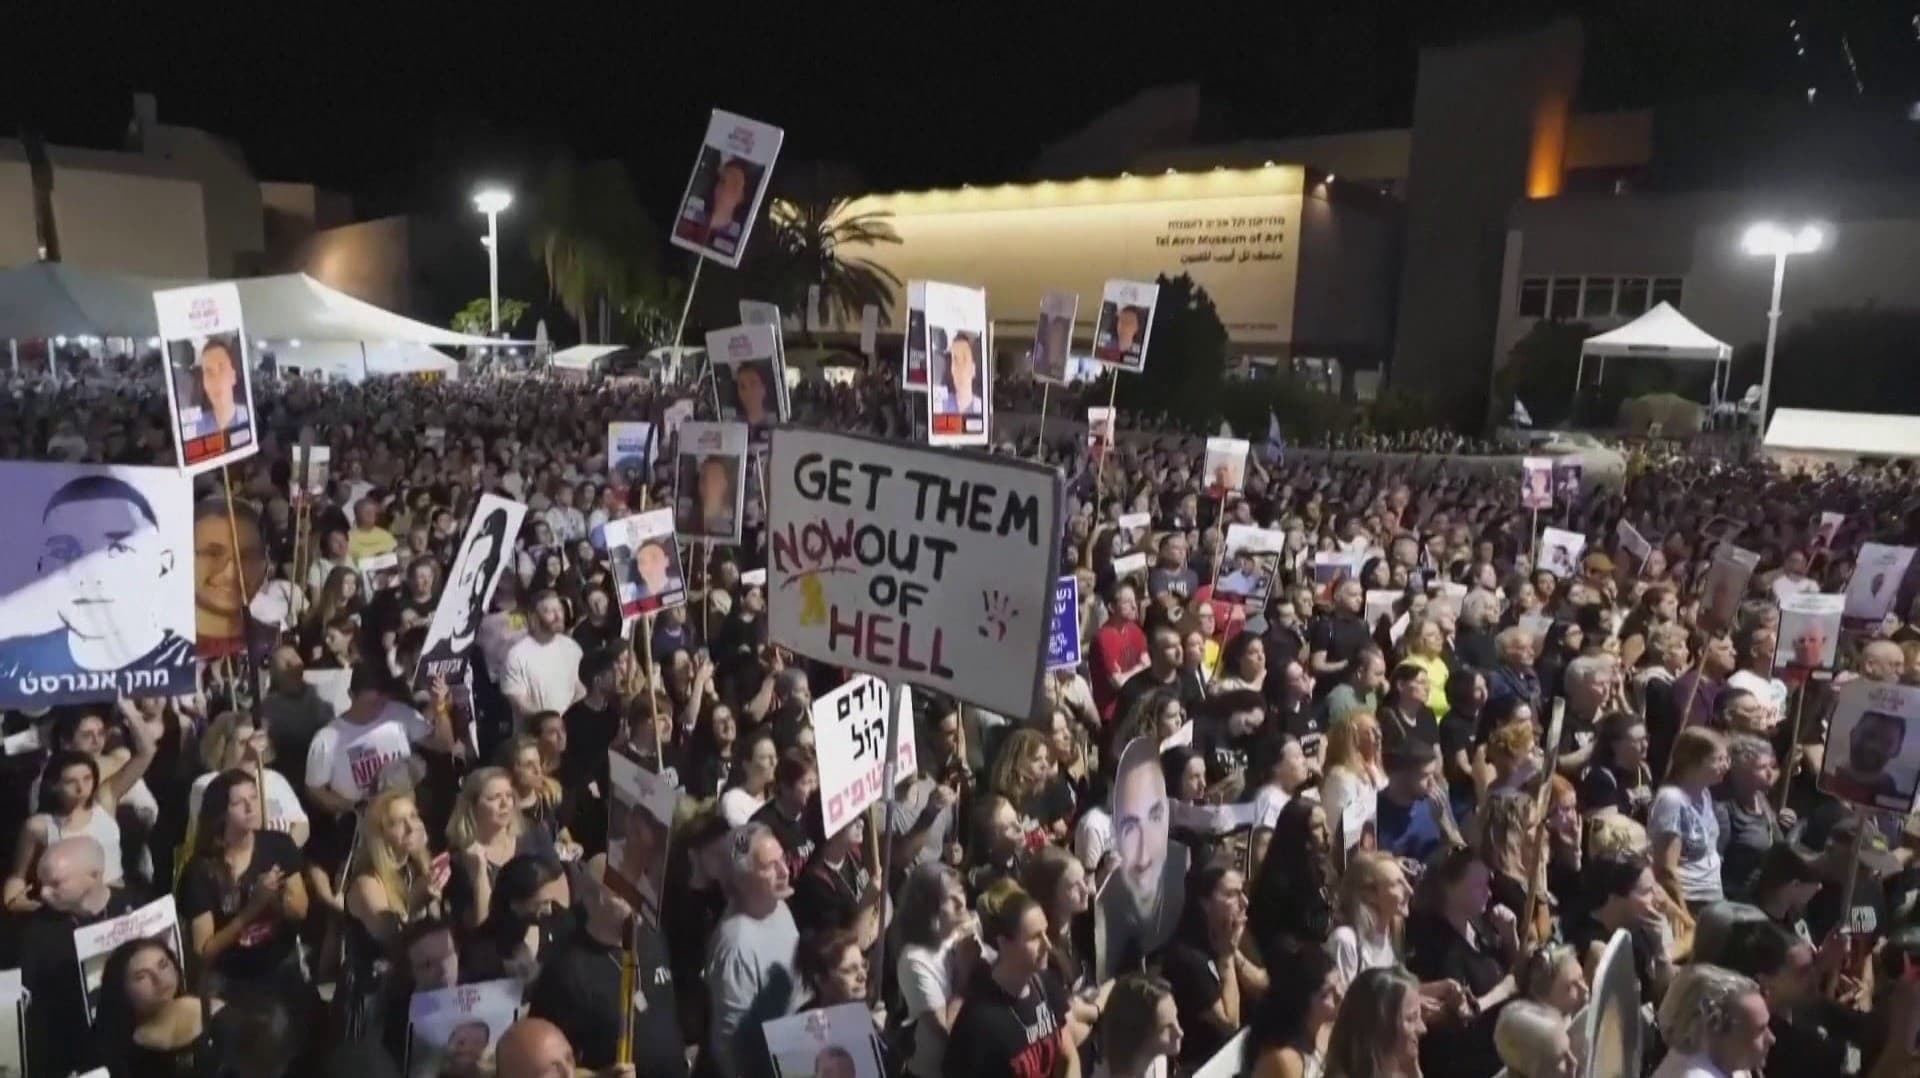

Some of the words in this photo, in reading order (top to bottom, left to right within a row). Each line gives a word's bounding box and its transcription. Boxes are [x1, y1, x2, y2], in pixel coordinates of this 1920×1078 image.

[1156, 234, 1170, 247] Tel
[1171, 235, 1196, 247] Aviv
[1198, 234, 1247, 246] Museum
[1249, 232, 1262, 244] of
[1265, 232, 1284, 244] Art
[794, 453, 893, 511] GET
[905, 470, 1039, 546] THEM
[773, 518, 855, 574] NOW
[854, 524, 958, 582] OUT
[869, 575, 929, 617] OF
[828, 604, 954, 679] HELL
[19, 670, 118, 696] אנגרסט
[124, 668, 170, 695] מתן
